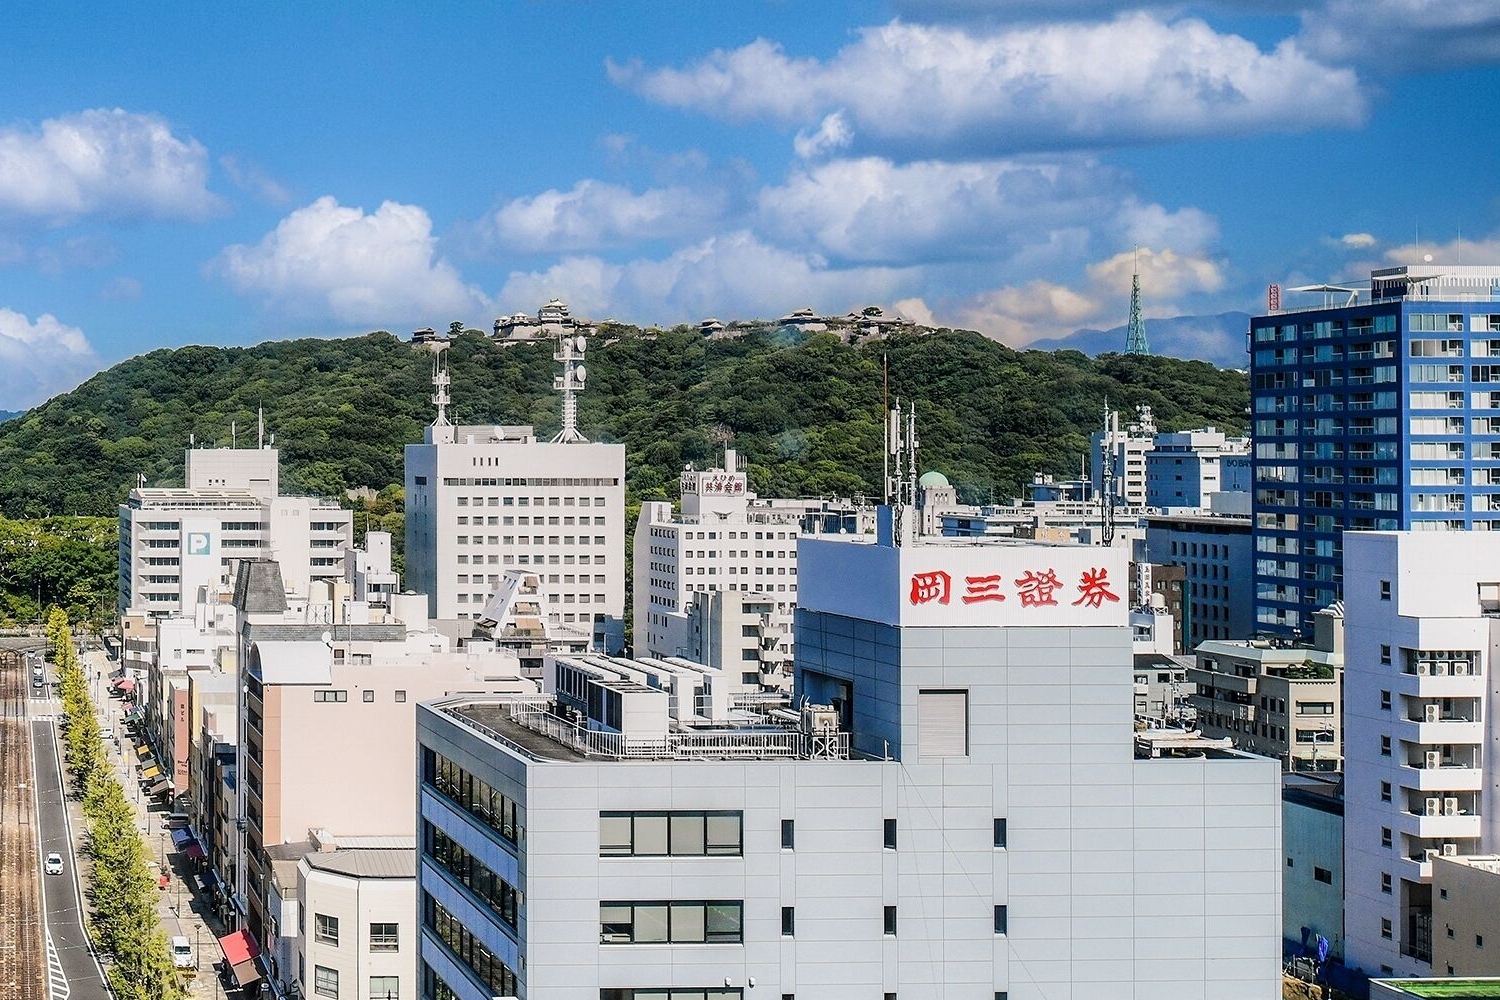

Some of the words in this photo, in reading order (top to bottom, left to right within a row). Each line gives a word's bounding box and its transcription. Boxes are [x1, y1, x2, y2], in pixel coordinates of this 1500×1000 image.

[190, 534, 208, 554] P
[908, 567, 1121, 610] 岡三證券
